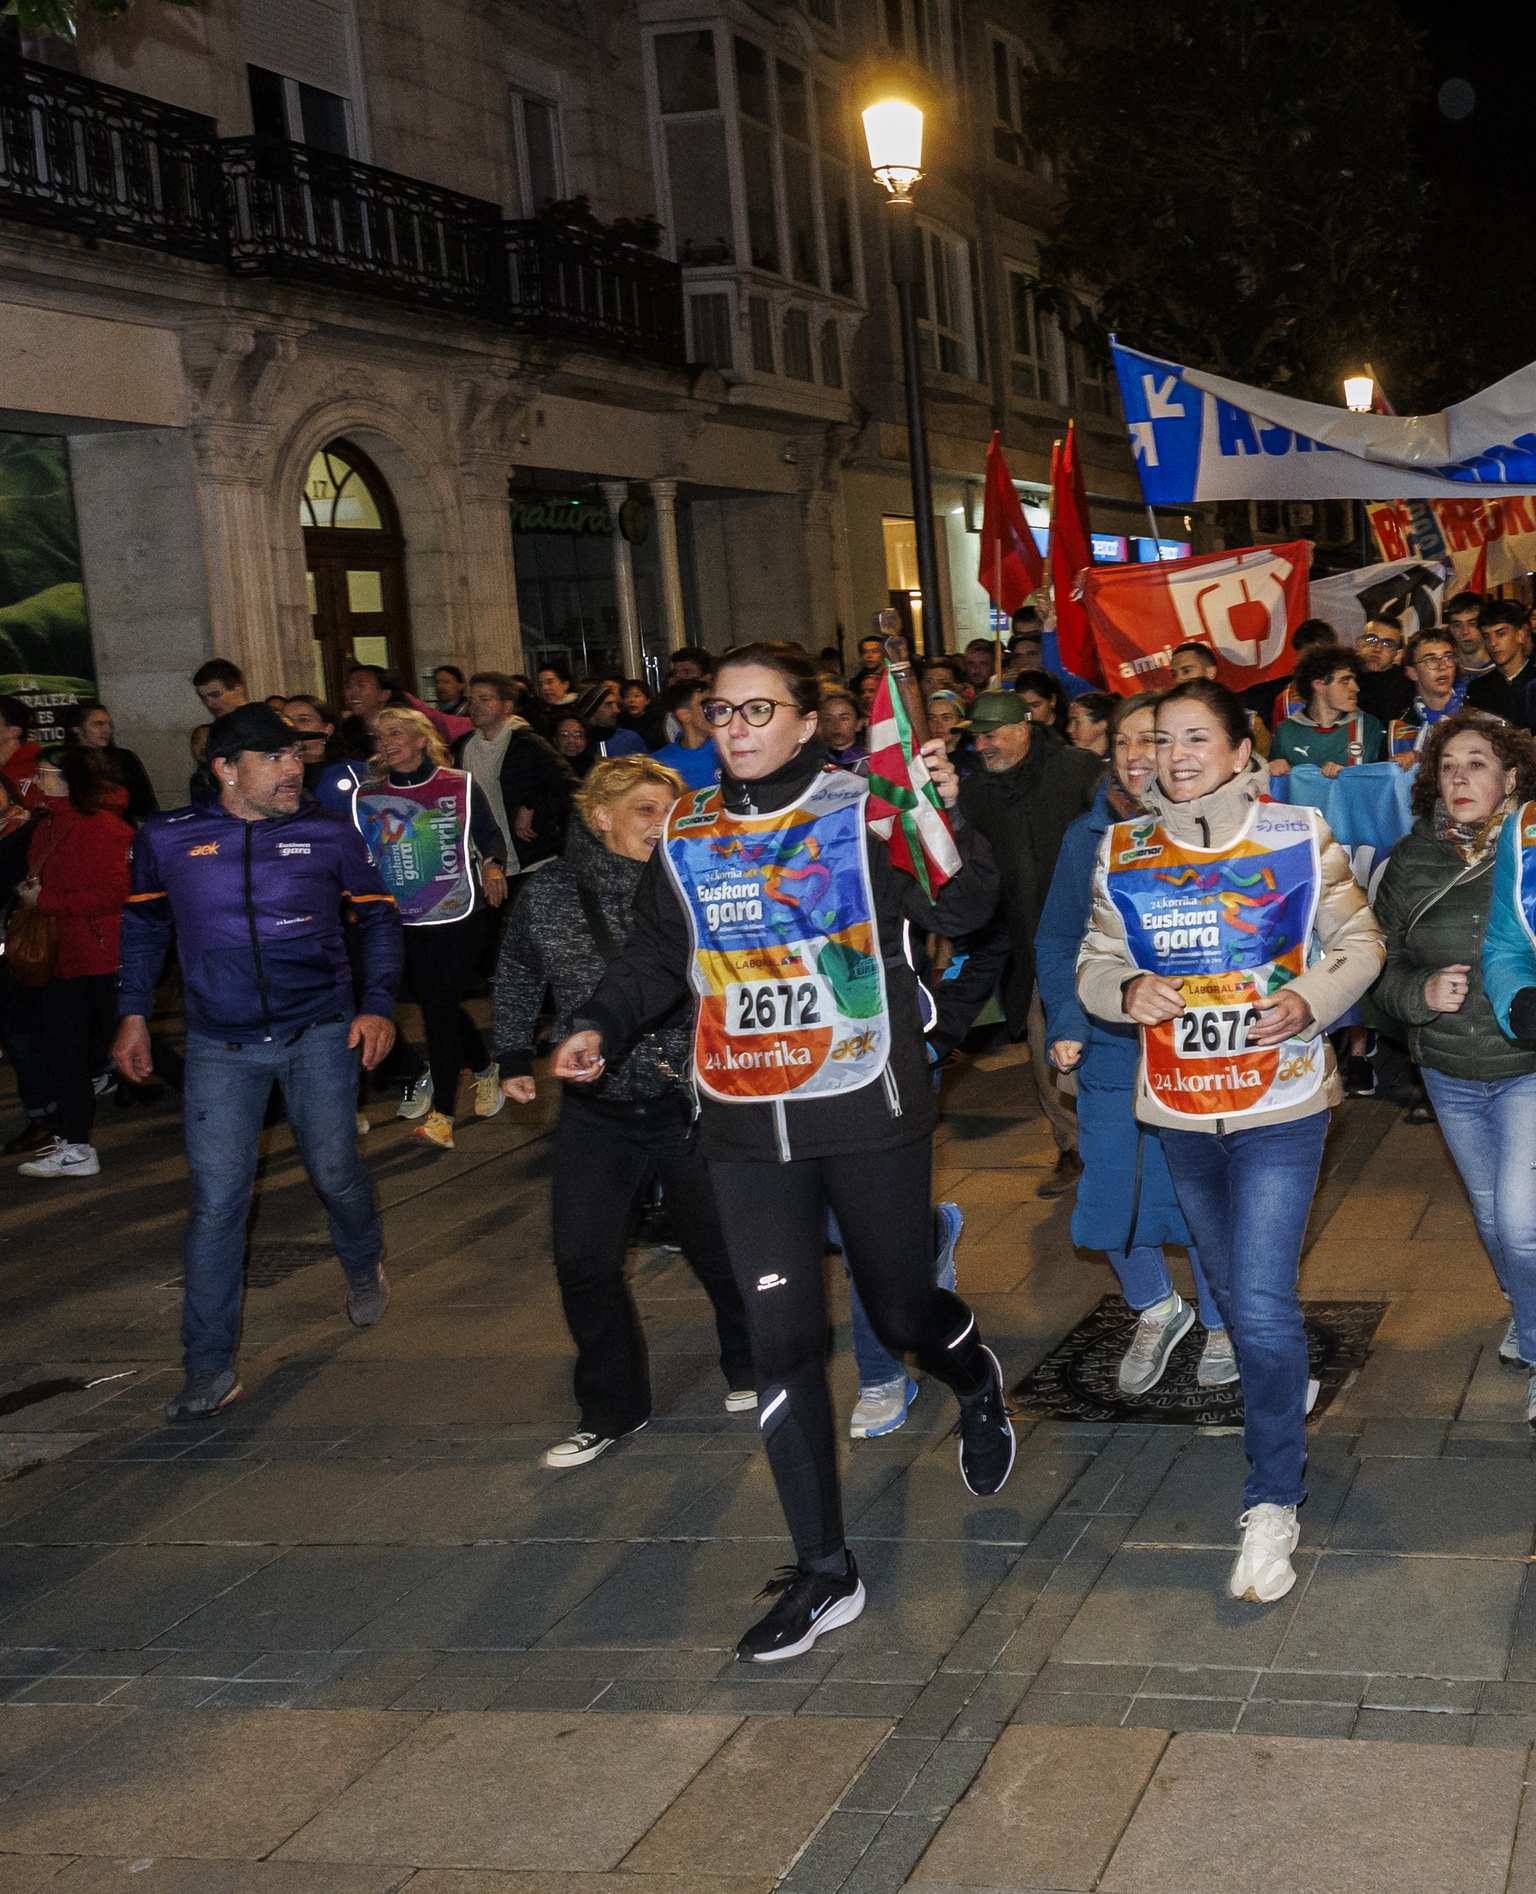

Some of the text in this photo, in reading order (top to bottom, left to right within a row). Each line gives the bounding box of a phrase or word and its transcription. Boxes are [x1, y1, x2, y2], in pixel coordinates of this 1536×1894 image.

[312, 480, 328, 498] 17
[37, 711, 55, 724] ES
[430, 795, 461, 881] korrika
[1275, 820, 1309, 832] eitb
[188, 841, 220, 856] aek
[401, 842, 419, 881] gara
[697, 882, 760, 902] Euskara
[706, 900, 763, 931] gara
[1142, 909, 1218, 930] Euskara
[1154, 926, 1220, 958] gara
[736, 958, 780, 970] LABORAL
[1189, 985, 1234, 994] LABORAL
[738, 983, 821, 1030] 2672
[705, 1041, 812, 1070] 24.korrika
[832, 1025, 877, 1061] aek
[1278, 1047, 1317, 1082] aek
[1155, 1066, 1262, 1092] 24.korrika
